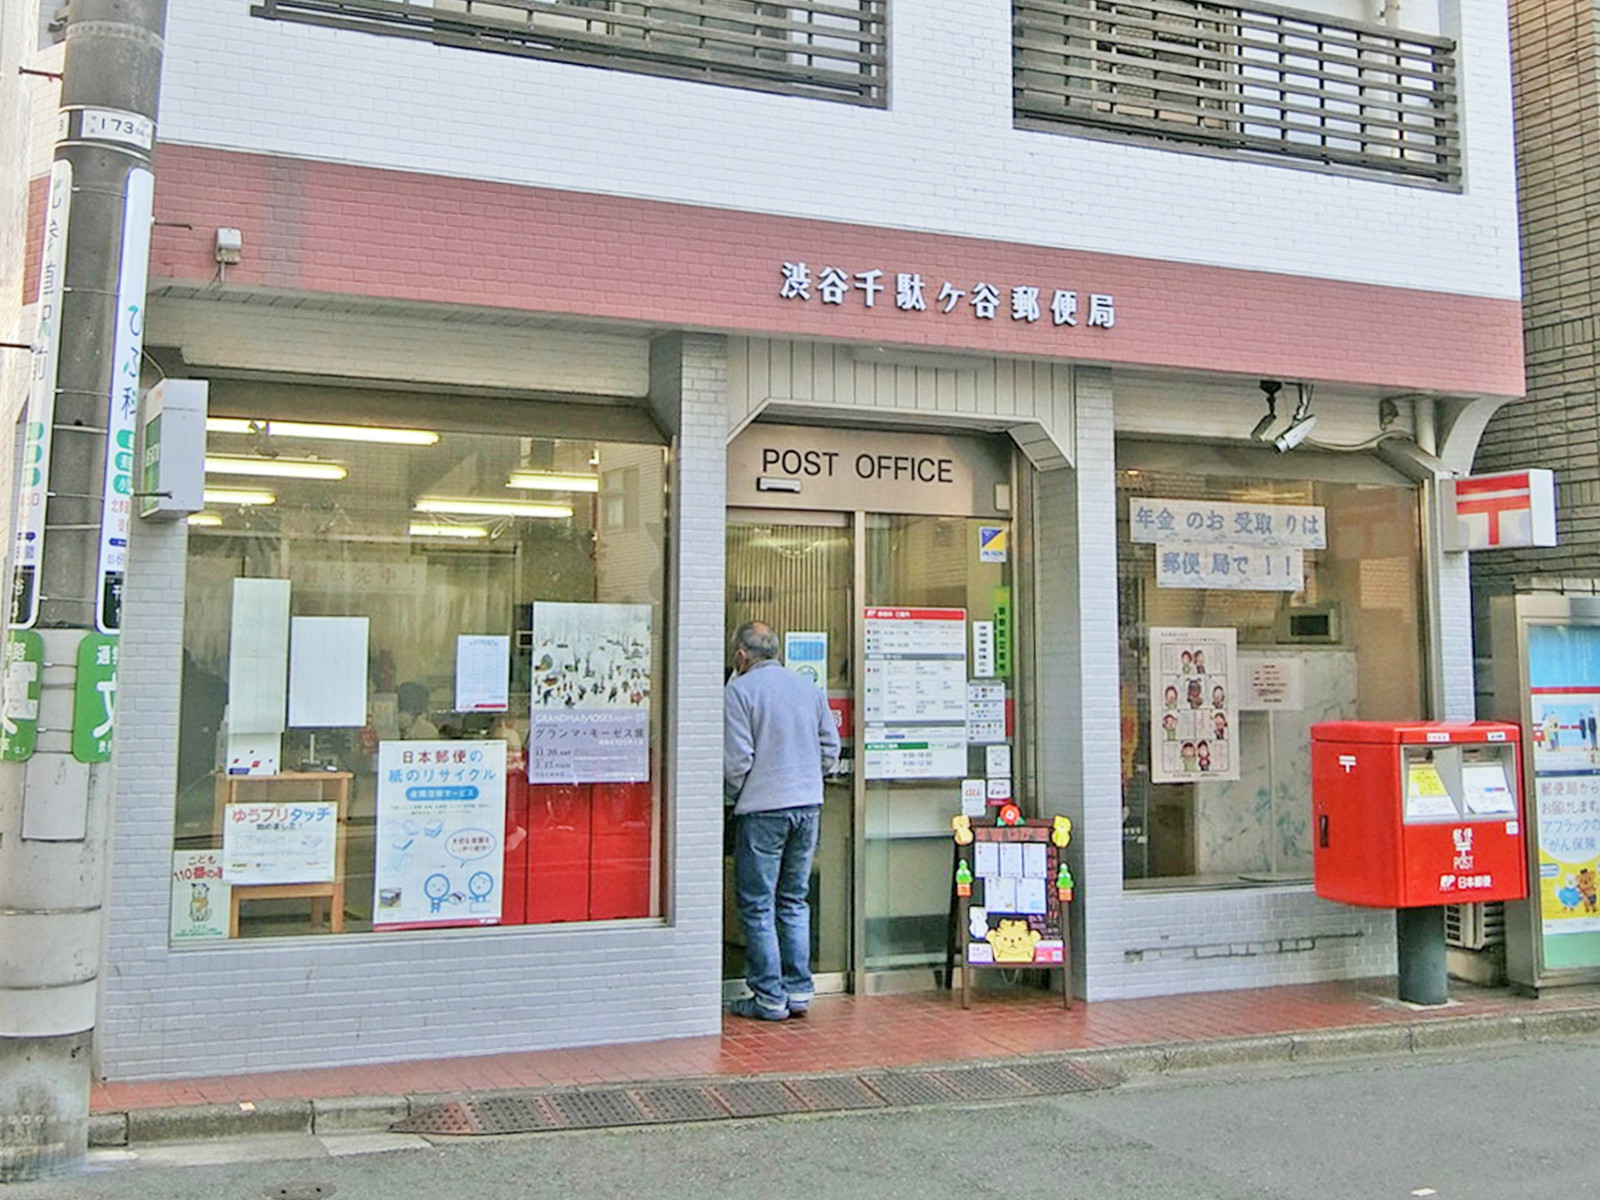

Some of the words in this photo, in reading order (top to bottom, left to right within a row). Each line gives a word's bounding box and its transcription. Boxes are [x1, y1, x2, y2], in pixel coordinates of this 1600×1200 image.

[101, 117, 134, 134] 173
[763, 448, 839, 477] POST
[855, 453, 954, 484] OFFICE
[402, 750, 483, 764] 日本郵便の
[388, 769, 497, 783] 紙のリサイクル
[188, 855, 217, 866] こども
